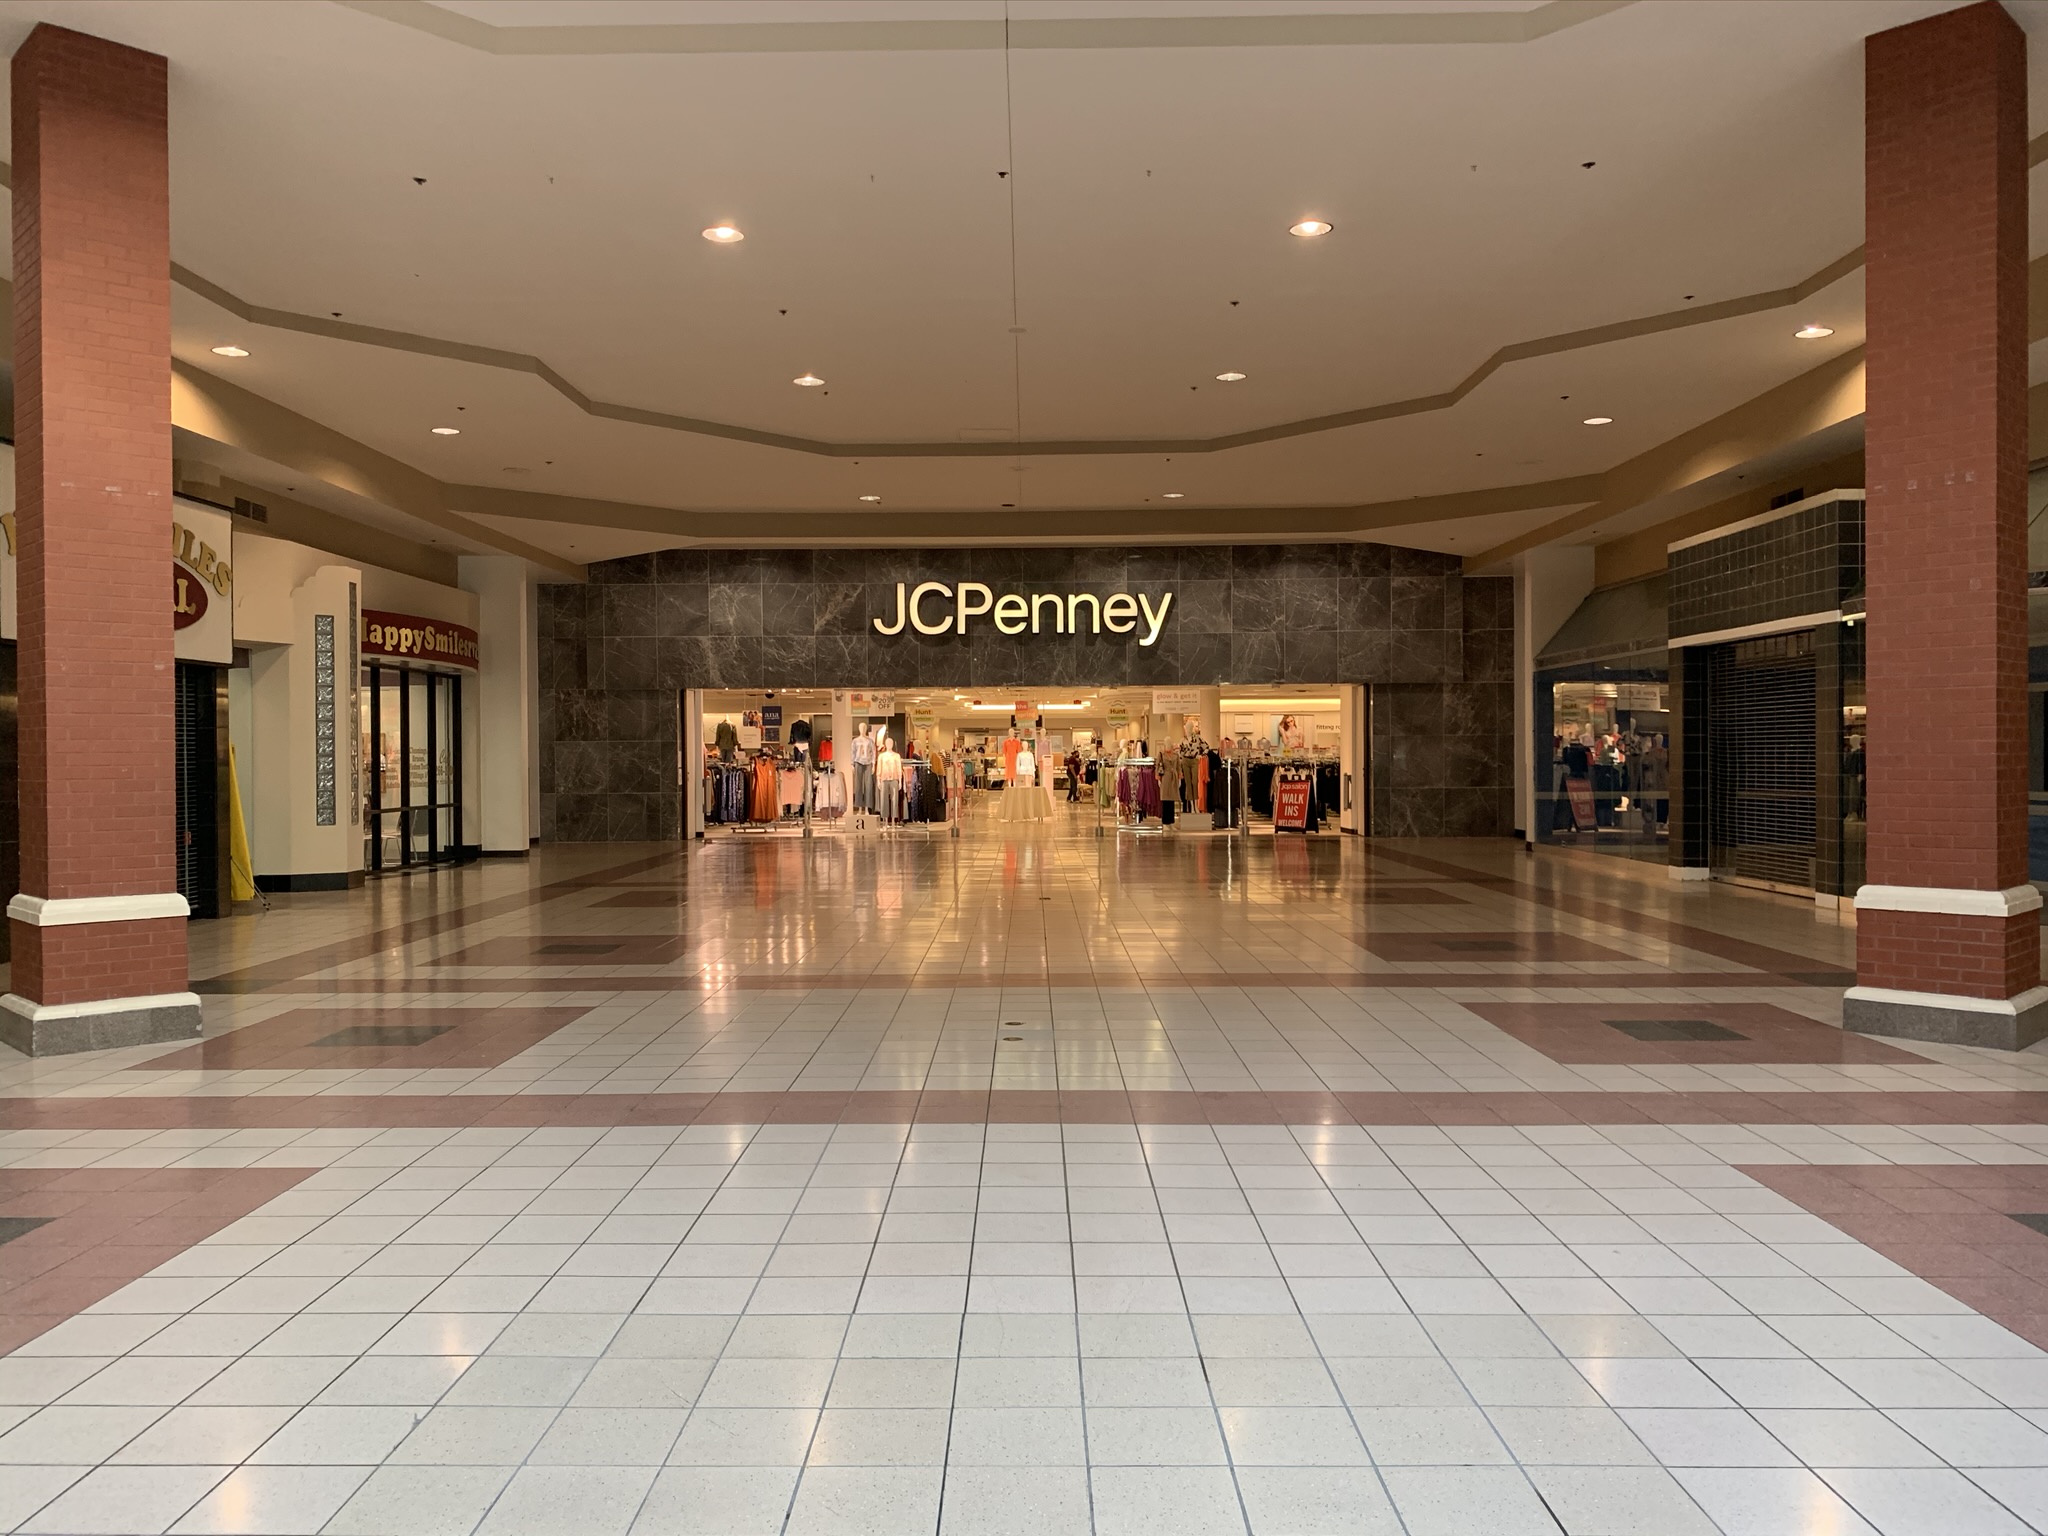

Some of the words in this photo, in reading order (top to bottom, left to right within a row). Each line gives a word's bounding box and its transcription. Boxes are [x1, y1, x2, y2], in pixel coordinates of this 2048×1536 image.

[873, 582, 1172, 646] JCPenney
[1281, 783, 1291, 791] jcp
[1282, 793, 1305, 804] WALK
[1284, 805, 1299, 817] INS
[1277, 819, 1303, 827] WELCOME
